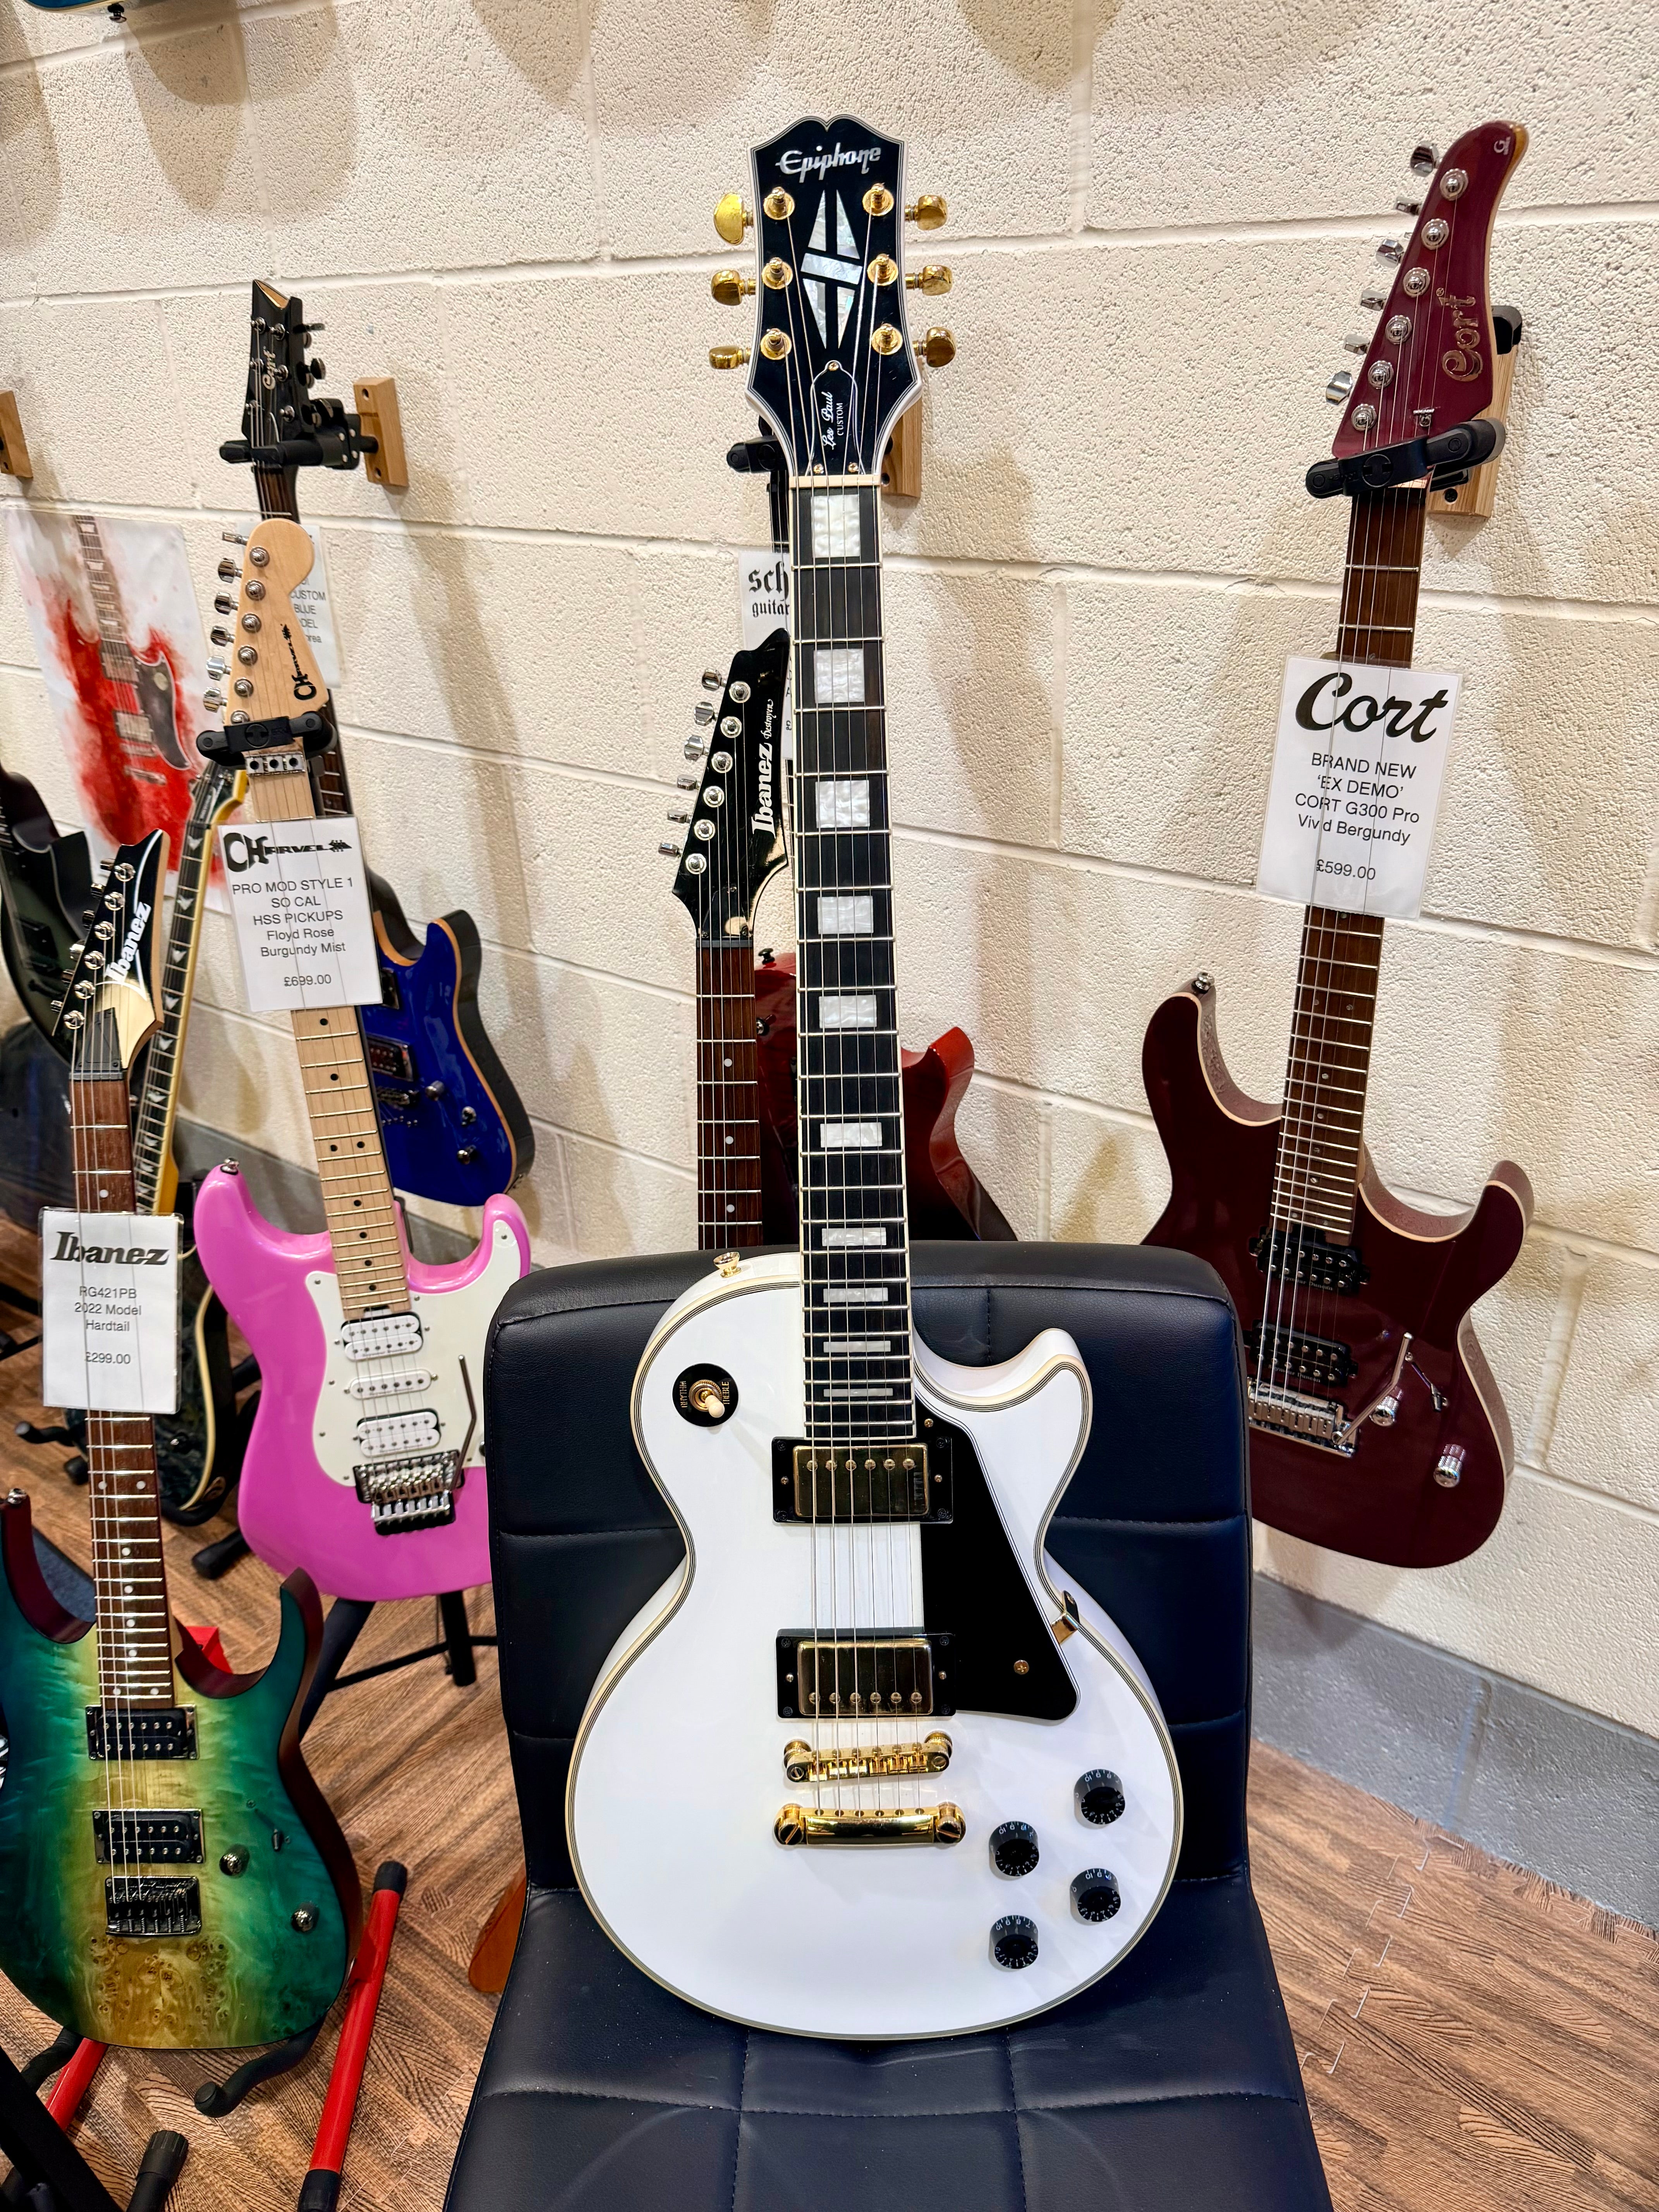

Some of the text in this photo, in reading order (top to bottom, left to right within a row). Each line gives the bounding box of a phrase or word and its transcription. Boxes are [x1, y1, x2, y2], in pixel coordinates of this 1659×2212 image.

[775, 143, 881, 183] Epiphone
[1438, 295, 1483, 382] Cort
[821, 391, 836, 450] Les Paul
[836, 403, 844, 436] CUSTOM
[294, 604, 316, 615] BLUE
[299, 618, 318, 629] DEL
[1295, 672, 1448, 743] Cort
[1311, 752, 1416, 779] BRAND NEW
[752, 742, 776, 838] Ibanez
[1295, 793, 1419, 823] CORT G300 Pro
[1336, 822, 1410, 845] Bergundy
[1316, 859, 1376, 880] £599.00
[232, 877, 353, 895] PRO MOD STYLE 1
[271, 896, 321, 908] SO CAL
[253, 910, 343, 926] HSS PICKUPS
[103, 902, 151, 985] Ibanez
[267, 928, 335, 942] Floyd Rose
[261, 942, 346, 958] Burgundy Mist
[284, 974, 332, 987] £699.00
[50, 1231, 169, 1266] Ibanez
[79, 1286, 137, 1298] RG421PB
[74, 1302, 142, 1316] 2022 Model
[86, 1319, 130, 1332] Hardtail
[85, 1352, 131, 1364] £299.00
[679, 1381, 688, 1408] RHYTHM
